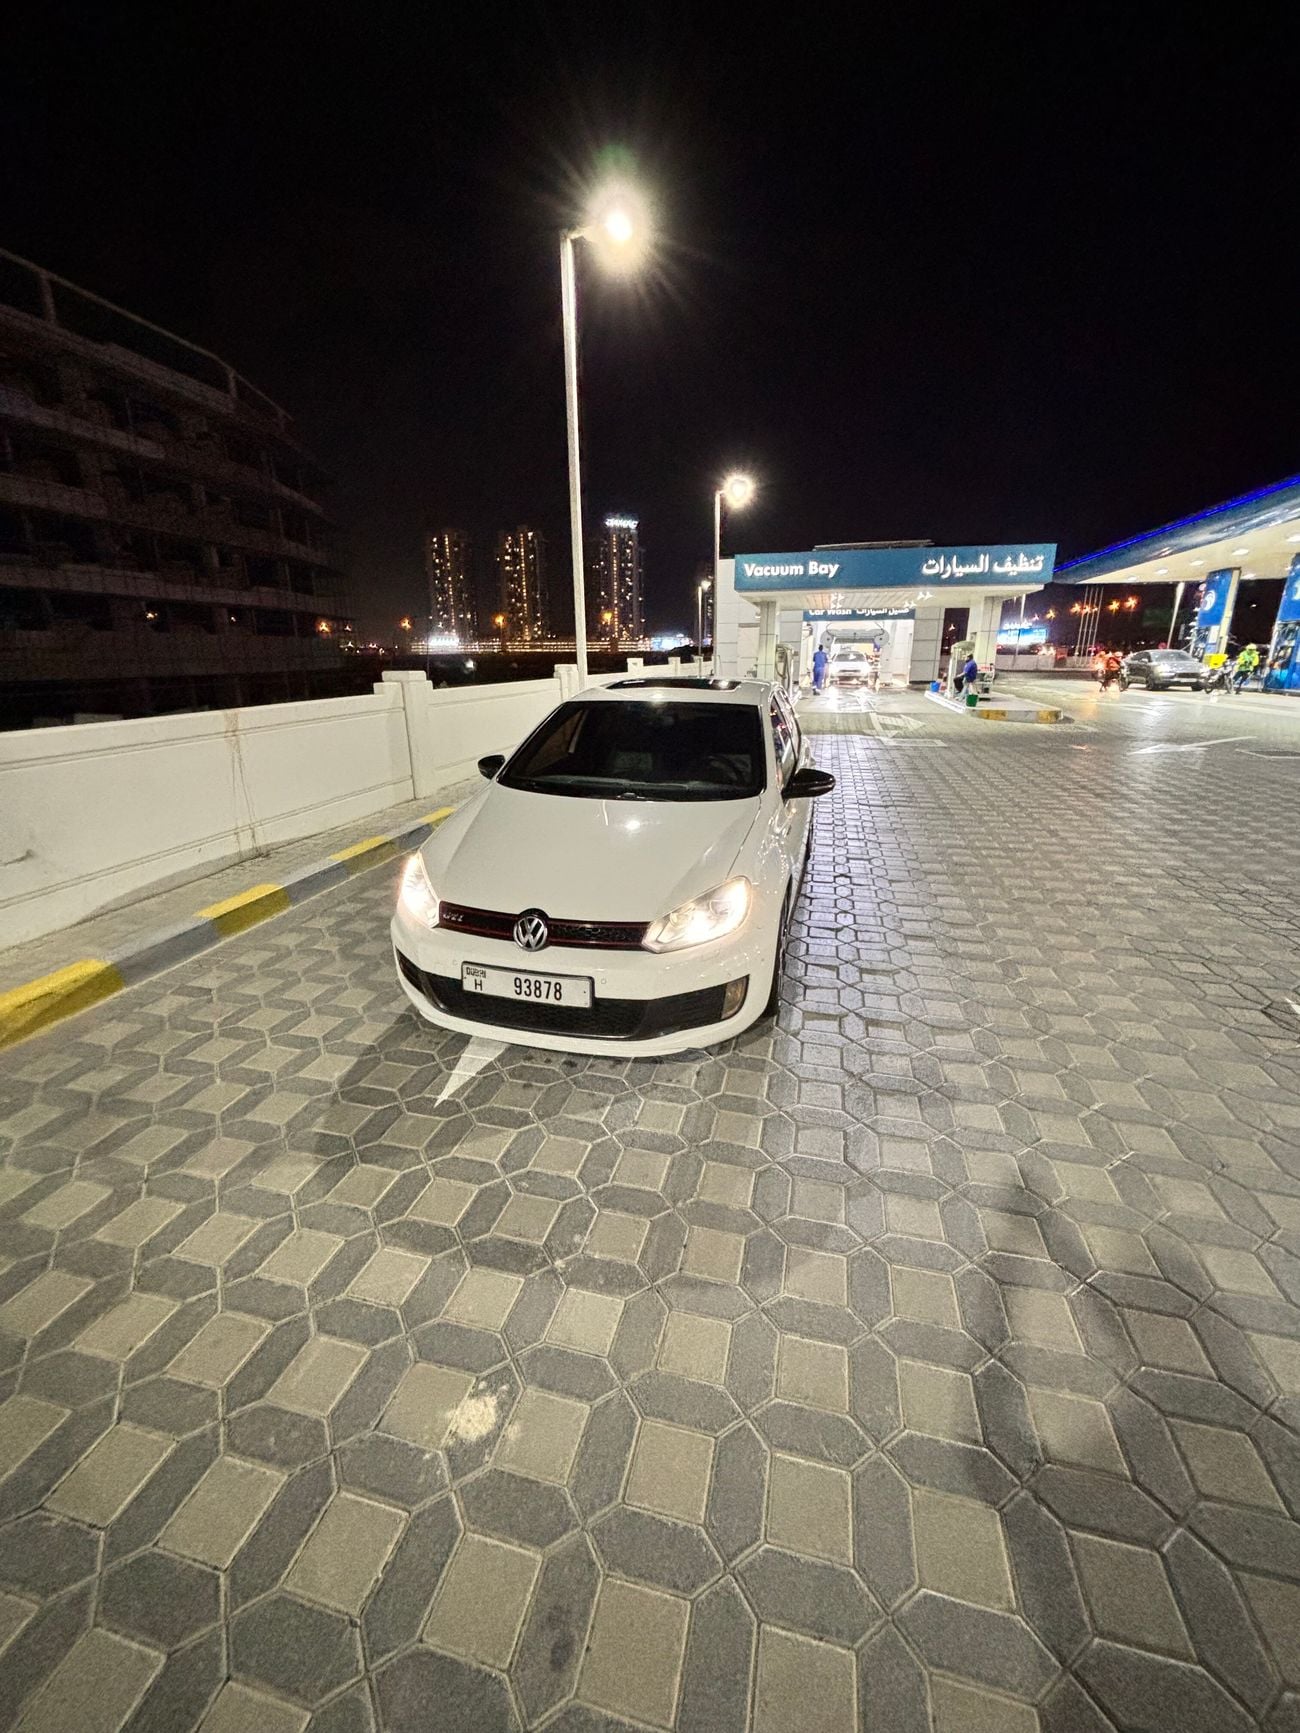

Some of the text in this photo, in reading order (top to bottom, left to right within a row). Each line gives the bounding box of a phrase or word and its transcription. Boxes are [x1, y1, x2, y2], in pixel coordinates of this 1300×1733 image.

[743, 561, 840, 579] Vacuum Bay
[921, 552, 1044, 579] تنظيف السيارات
[474, 976, 562, 1001] H 93878
